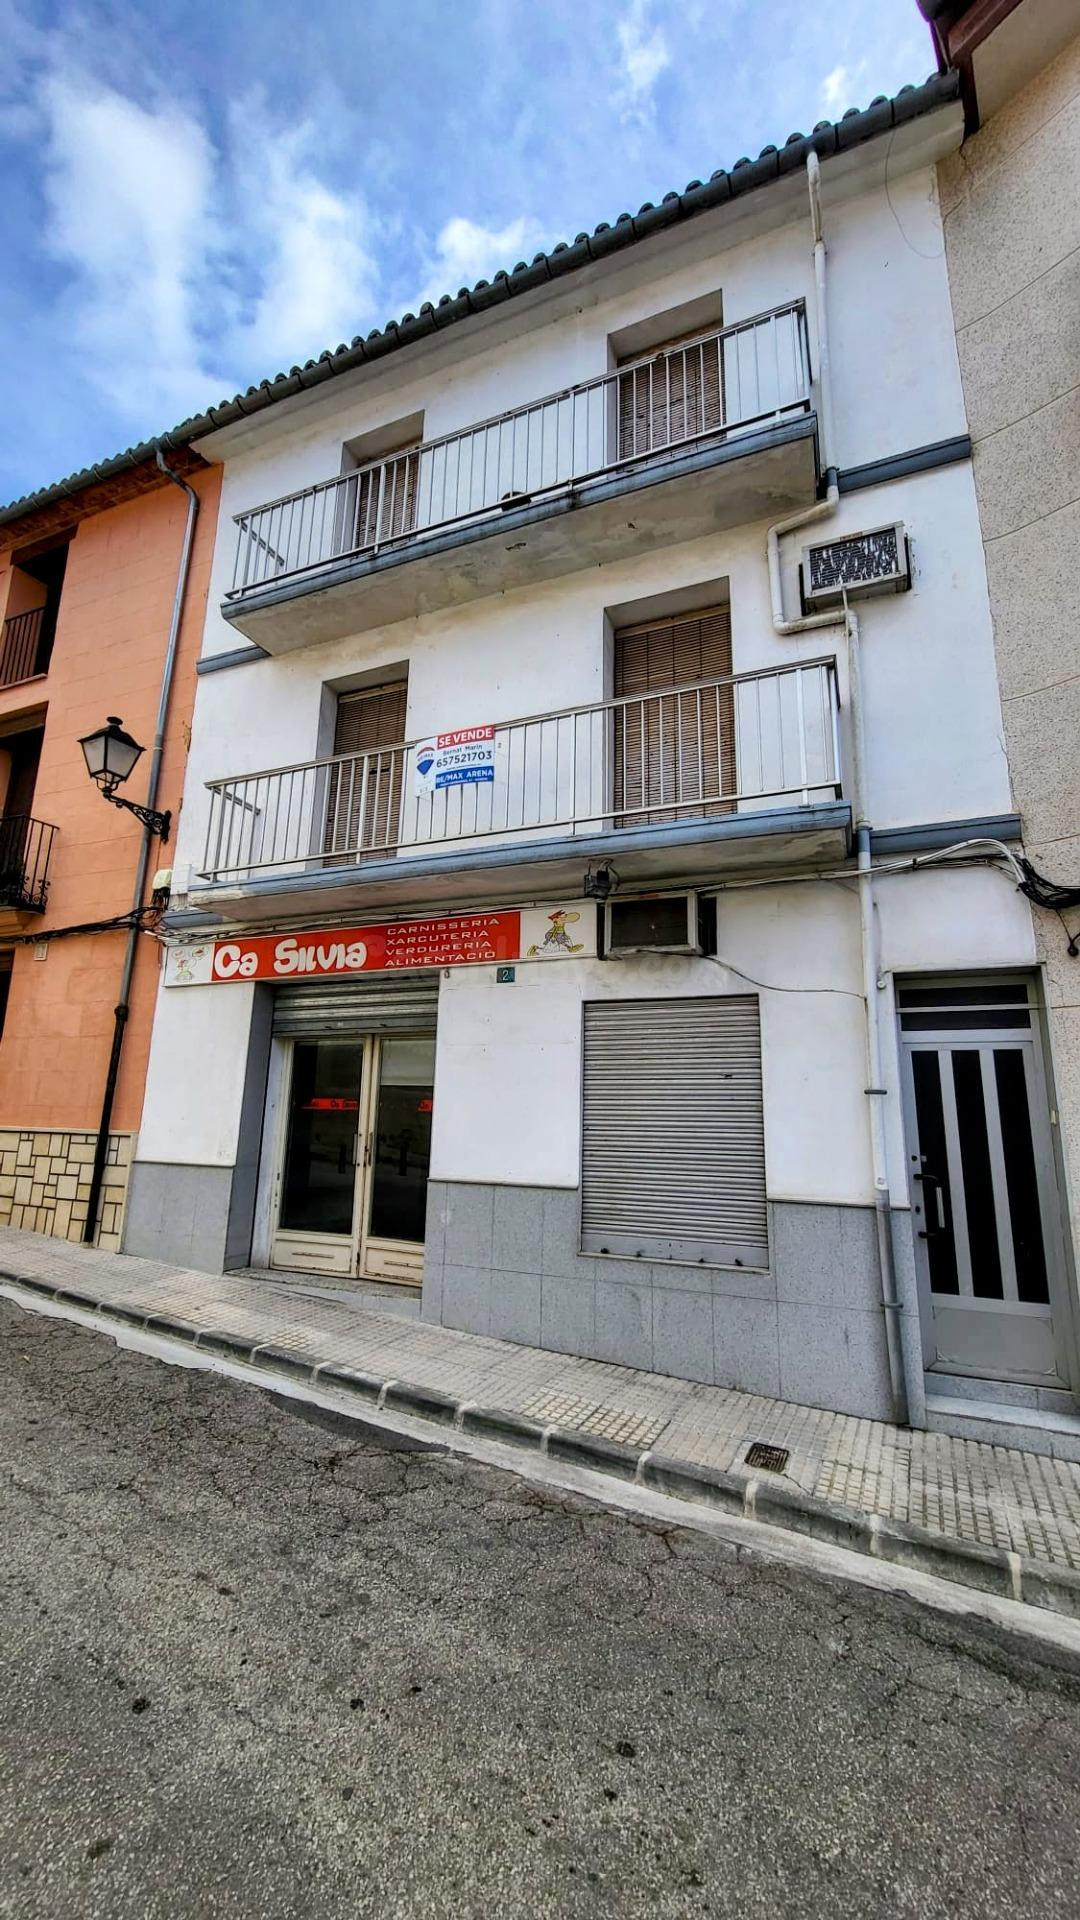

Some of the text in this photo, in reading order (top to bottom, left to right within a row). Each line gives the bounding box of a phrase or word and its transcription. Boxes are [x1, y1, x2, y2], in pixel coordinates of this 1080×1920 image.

[438, 727, 493, 748] SE VENDE
[436, 750, 492, 768] 657521703
[436, 772, 463, 783] RE/MAX
[466, 769, 493, 778] ARENA
[387, 918, 500, 935] CARNISSERIA
[386, 930, 489, 946] XARCUTERIA
[385, 941, 492, 956] VERDURERIA
[214, 945, 258, 977] Ca
[502, 969, 509, 981] 2
